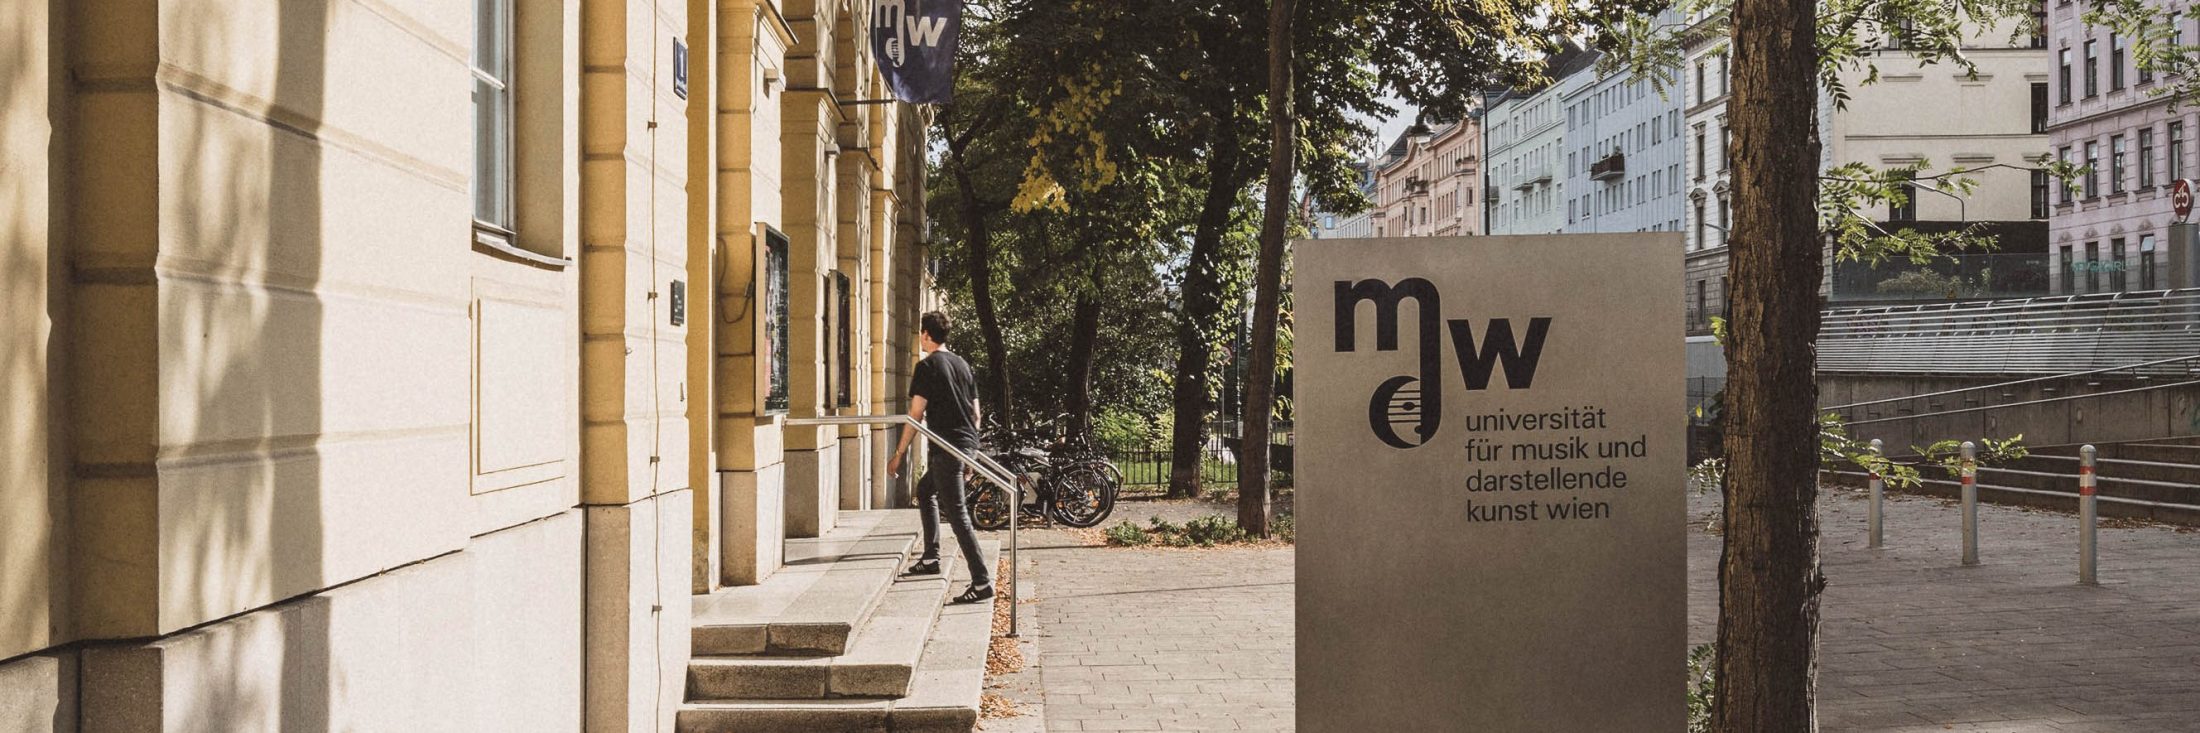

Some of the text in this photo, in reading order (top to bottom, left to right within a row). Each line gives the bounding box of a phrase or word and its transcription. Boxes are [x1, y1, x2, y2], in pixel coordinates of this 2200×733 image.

[1466, 406, 1607, 432] universität
[1465, 434, 1647, 462] für musik und
[1466, 465, 1628, 492] darstellende
[1467, 497, 1610, 522] kunst wien
